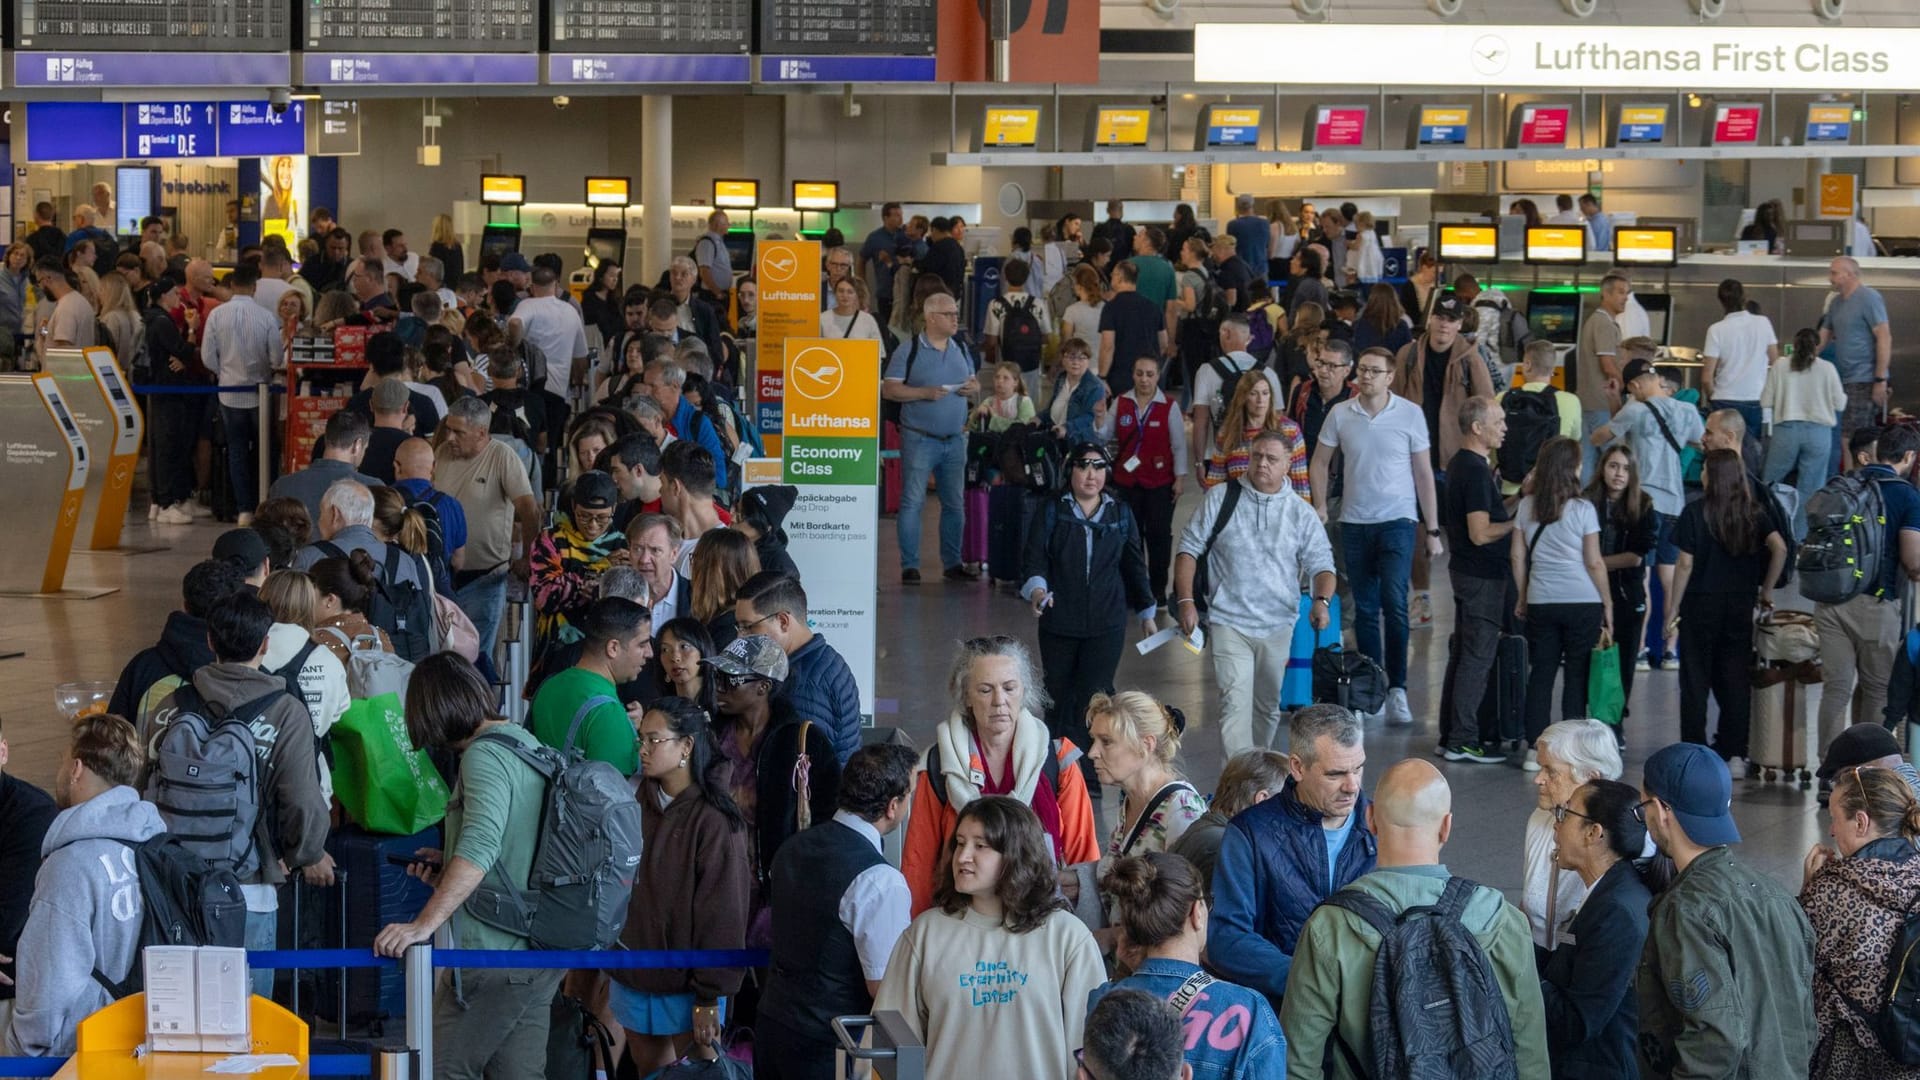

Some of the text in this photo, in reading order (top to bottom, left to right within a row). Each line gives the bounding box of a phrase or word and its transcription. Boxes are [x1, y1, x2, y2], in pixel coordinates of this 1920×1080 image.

[1535, 42, 1889, 73] Lufthansa First Class
[151, 104, 166, 115] Abflug
[241, 104, 256, 115] Abflug
[1261, 162, 1346, 176] Business Class
[1535, 160, 1581, 173] Business
[762, 291, 815, 301] Lufthansa
[791, 413, 871, 429] Lufthansa
[791, 445, 862, 461] Economy
[790, 462, 833, 476] Class
[795, 493, 857, 504] epäckabgabe
[808, 503, 830, 512] Drop
[790, 522, 850, 530] Mit Bordkarte
[789, 532, 867, 541] with boarding pass
[837, 608, 865, 616] Partner
[975, 960, 1008, 972] One
[959, 969, 1028, 987] Eternity
[972, 987, 1018, 1007] Later
